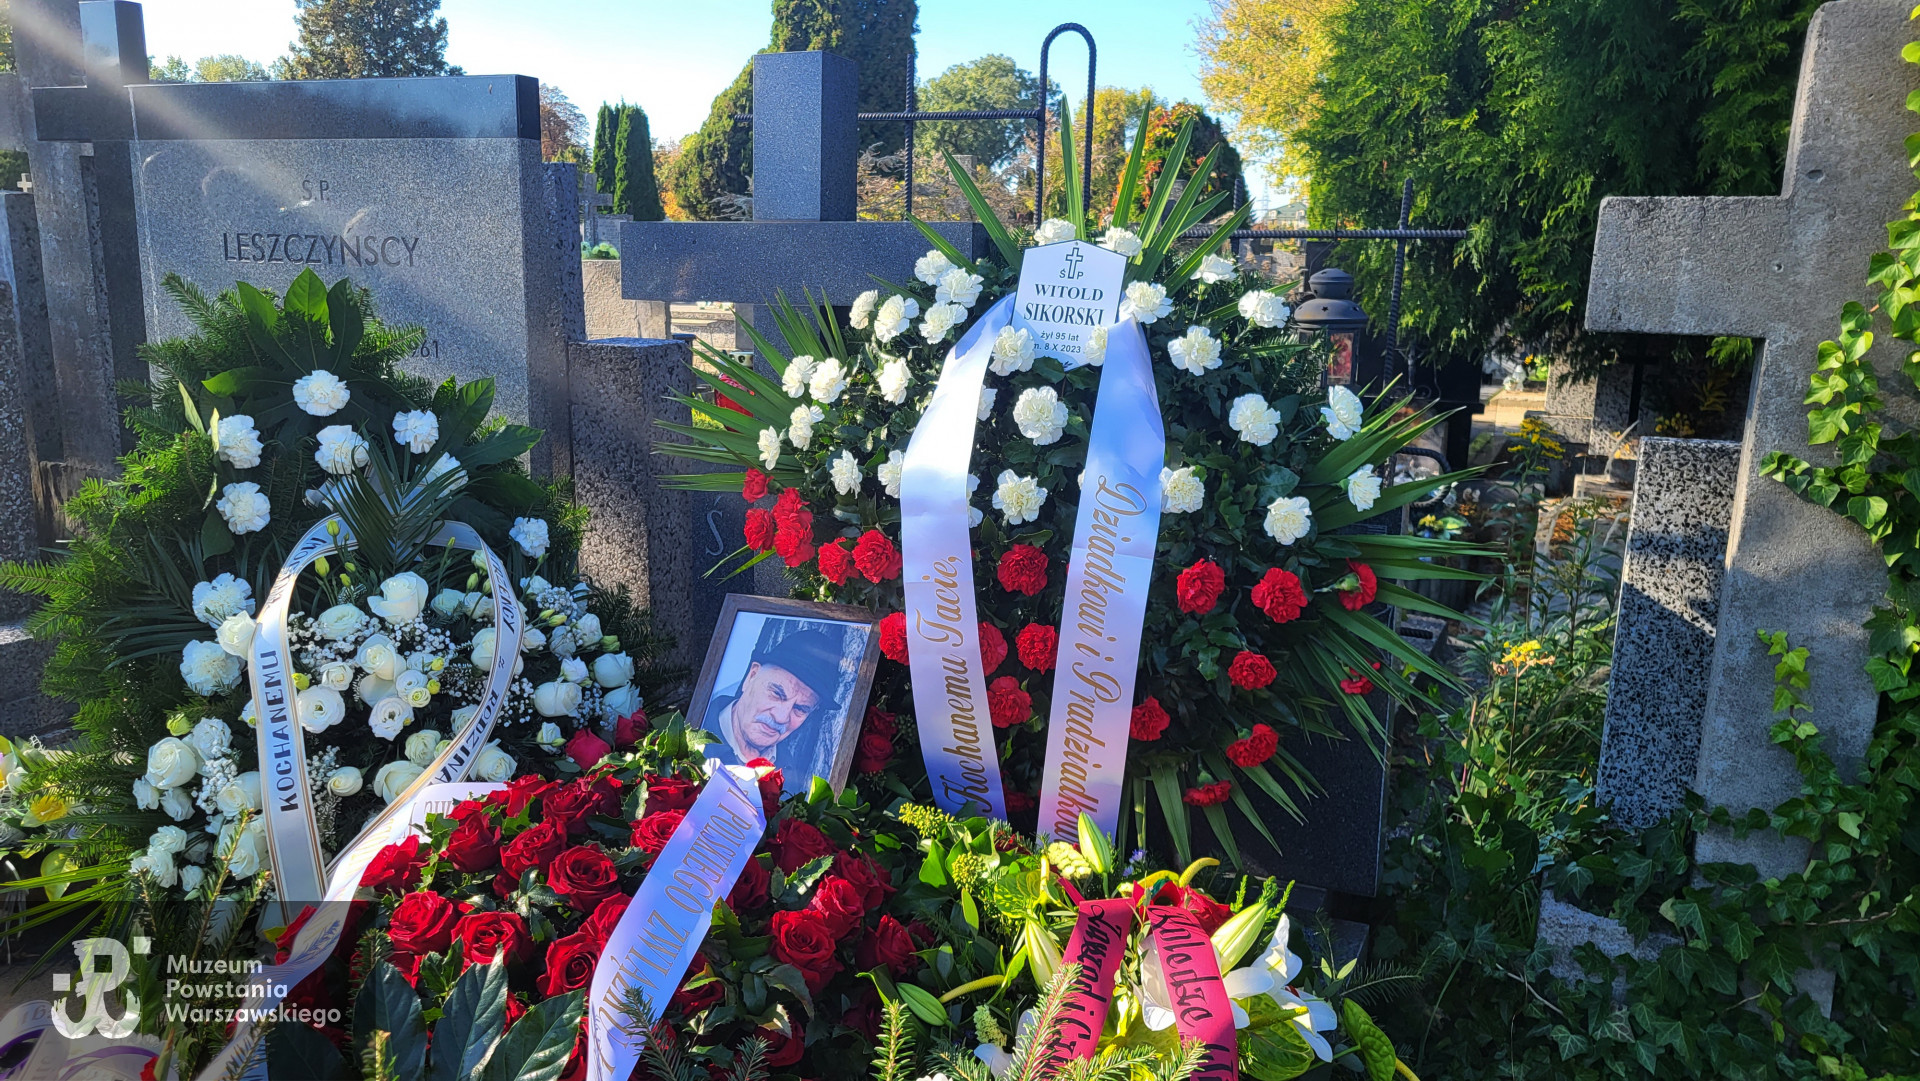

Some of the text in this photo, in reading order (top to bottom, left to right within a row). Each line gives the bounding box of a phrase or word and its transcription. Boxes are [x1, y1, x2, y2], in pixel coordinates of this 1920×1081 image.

[1035, 283, 1104, 302] WITOLD
[1076, 271, 1084, 280] P
[1023, 302, 1105, 327] SIKORSKI
[1040, 330, 1079, 342] żył 95 lat
[1044, 343, 1050, 351] 8
[1052, 343, 1059, 352] X
[1060, 344, 1081, 354] 2023
[411, 340, 440, 359] 61
[1077, 475, 1148, 642] Dziadkowi
[915, 556, 993, 813] Kochanemu Tacie,
[260, 650, 300, 812] KOCHANEMU
[1053, 662, 1122, 843] Pradziadkow
[663, 802, 753, 915] POLSKIEGO
[1150, 907, 1221, 1028] Koledze
